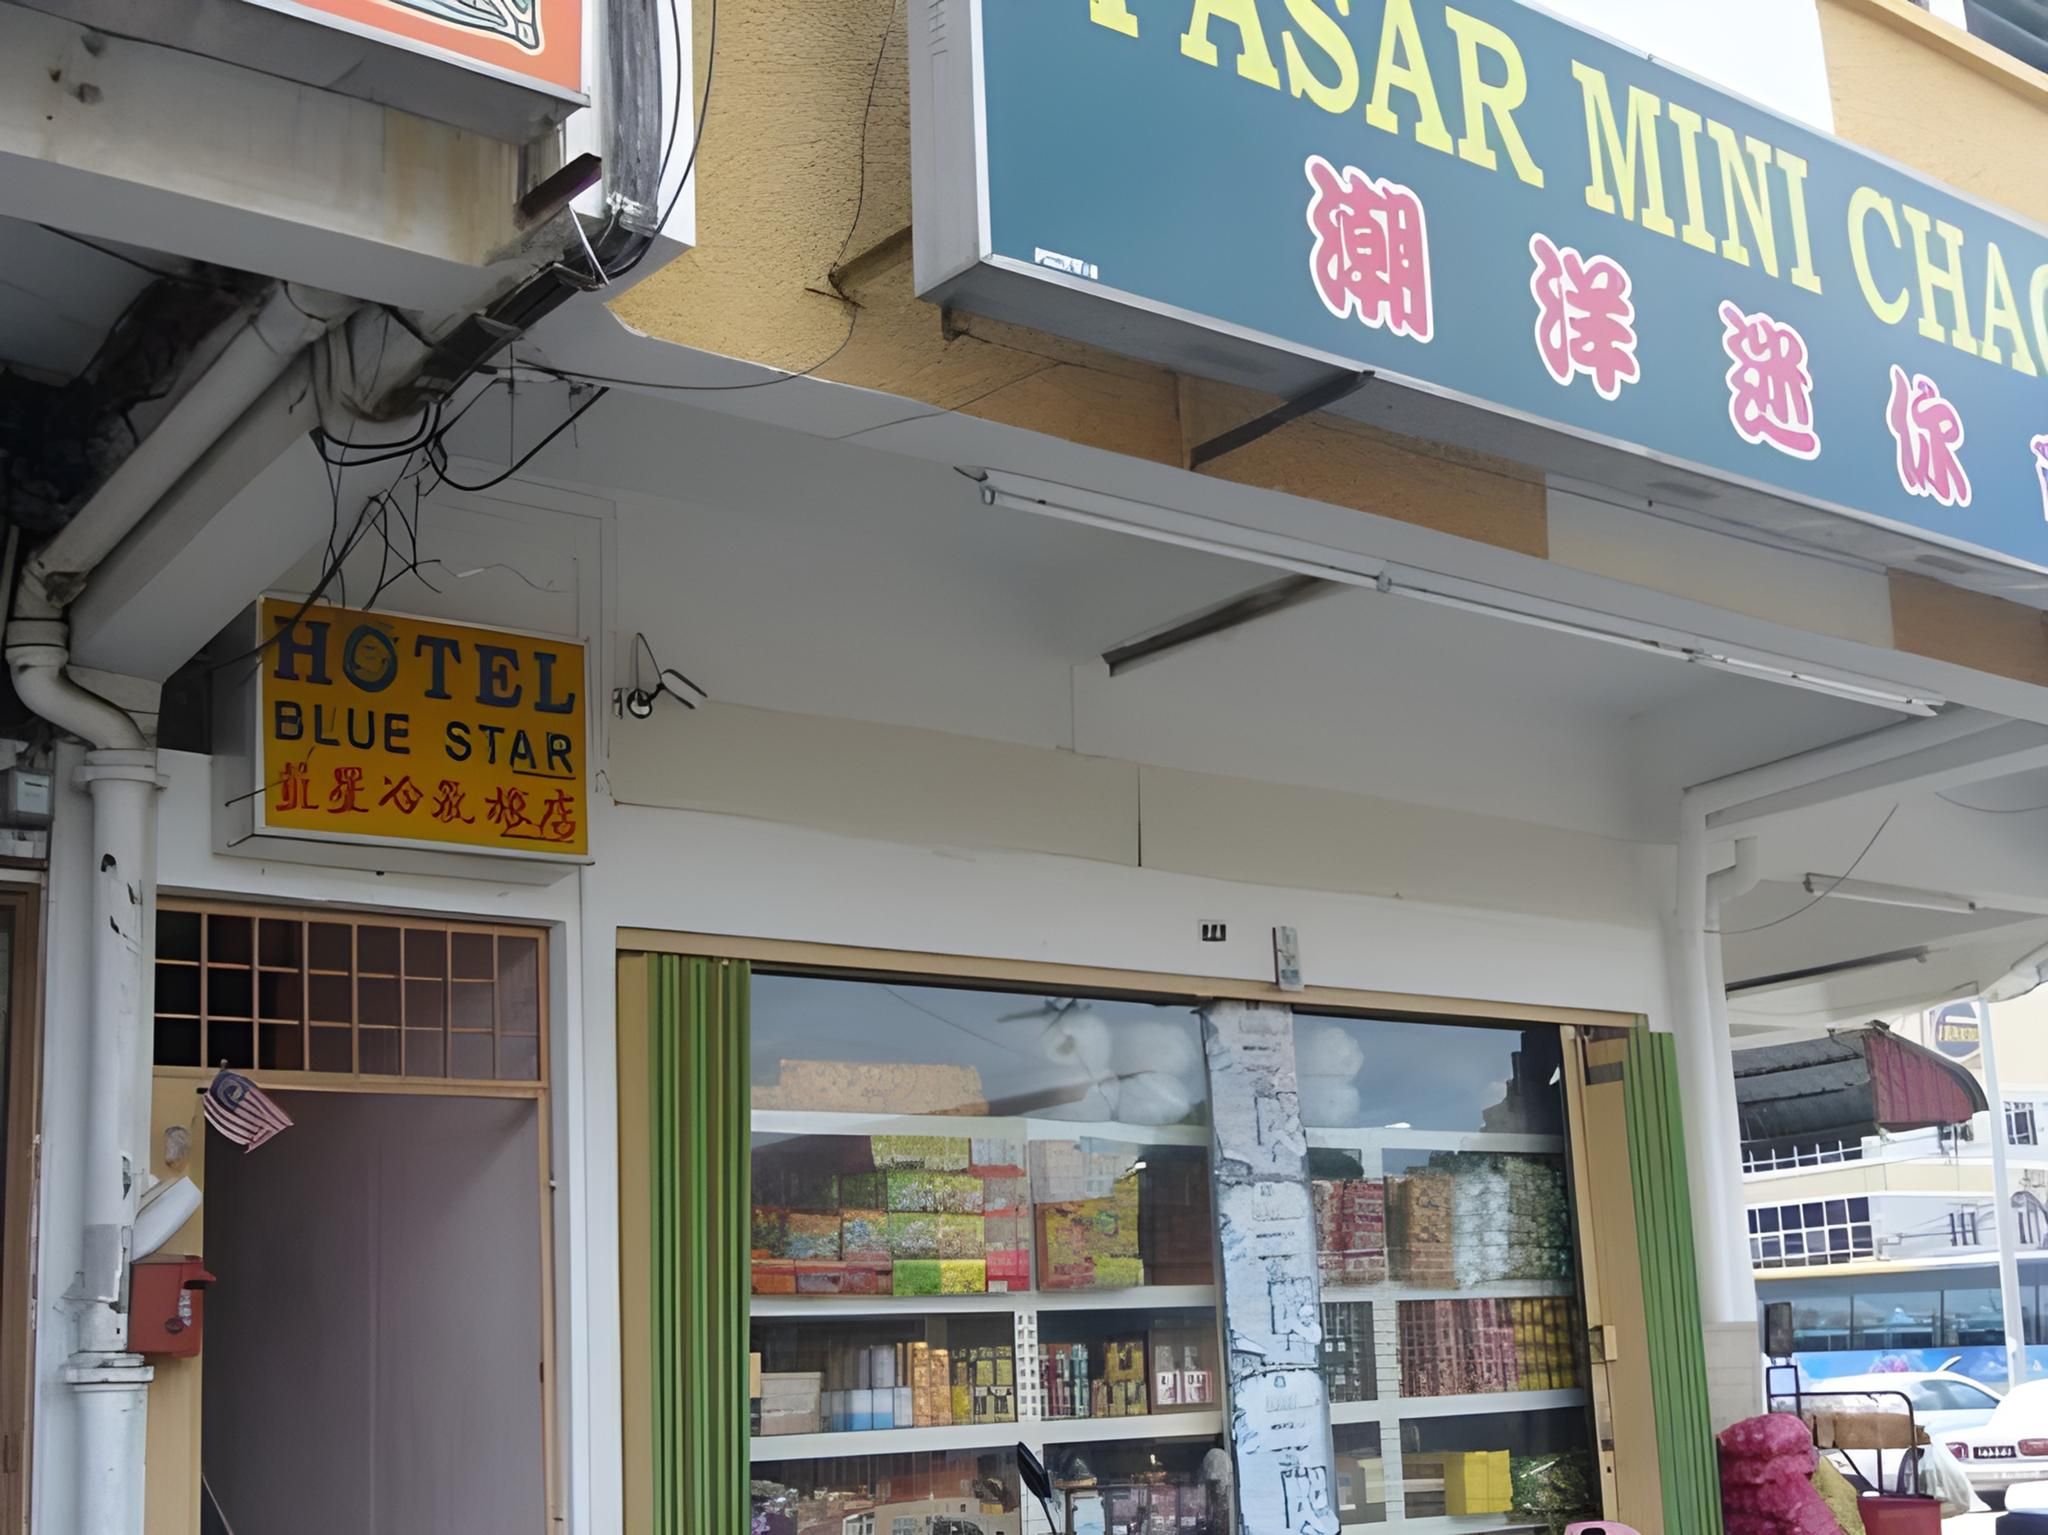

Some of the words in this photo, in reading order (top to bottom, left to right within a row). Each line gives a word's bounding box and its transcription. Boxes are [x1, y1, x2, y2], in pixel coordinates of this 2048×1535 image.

[1090, 0, 1544, 188] ASAR
[1572, 59, 1822, 295] MINI
[1848, 186, 2048, 378] CHA
[274, 616, 576, 714] HOTEL
[275, 701, 411, 755] BLUE
[445, 721, 576, 774] STAR
